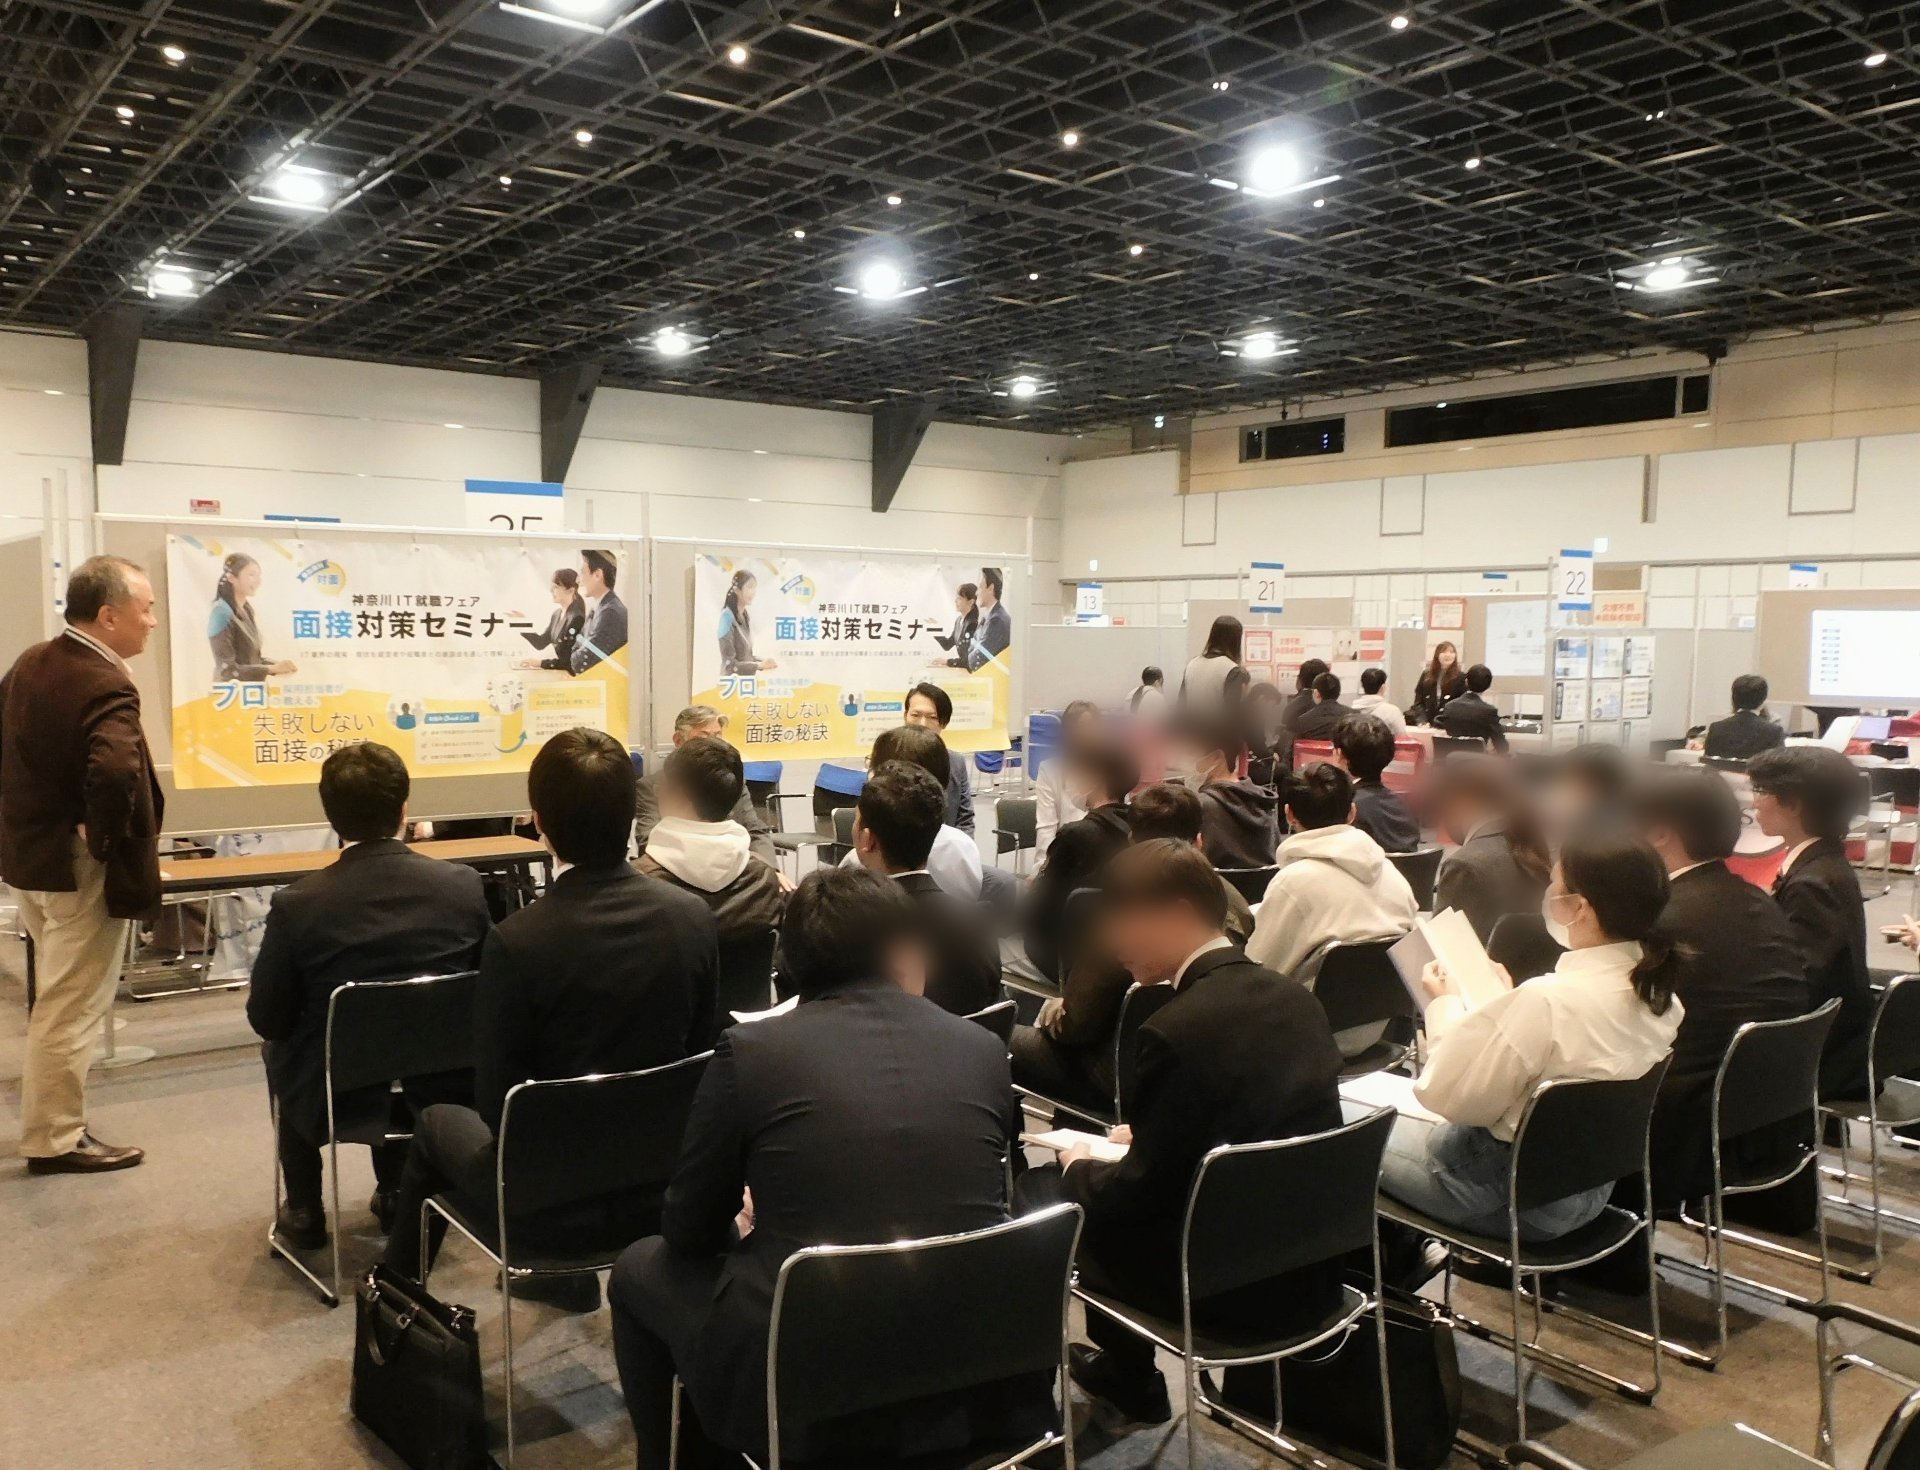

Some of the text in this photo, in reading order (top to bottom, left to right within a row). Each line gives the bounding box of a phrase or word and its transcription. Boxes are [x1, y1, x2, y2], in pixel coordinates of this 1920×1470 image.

[1258, 580, 1275, 602] 21
[1565, 570, 1586, 595] 22
[1083, 595, 1097, 610] 13
[292, 609, 534, 640] 面接対策セミナー
[775, 616, 944, 641] 面接対策セミナー
[212, 683, 264, 707] プロ
[719, 677, 757, 697] プロ
[746, 703, 830, 722] 失敗しない
[254, 712, 374, 737] 失敗しない
[746, 723, 829, 744] 面接の秘訣
